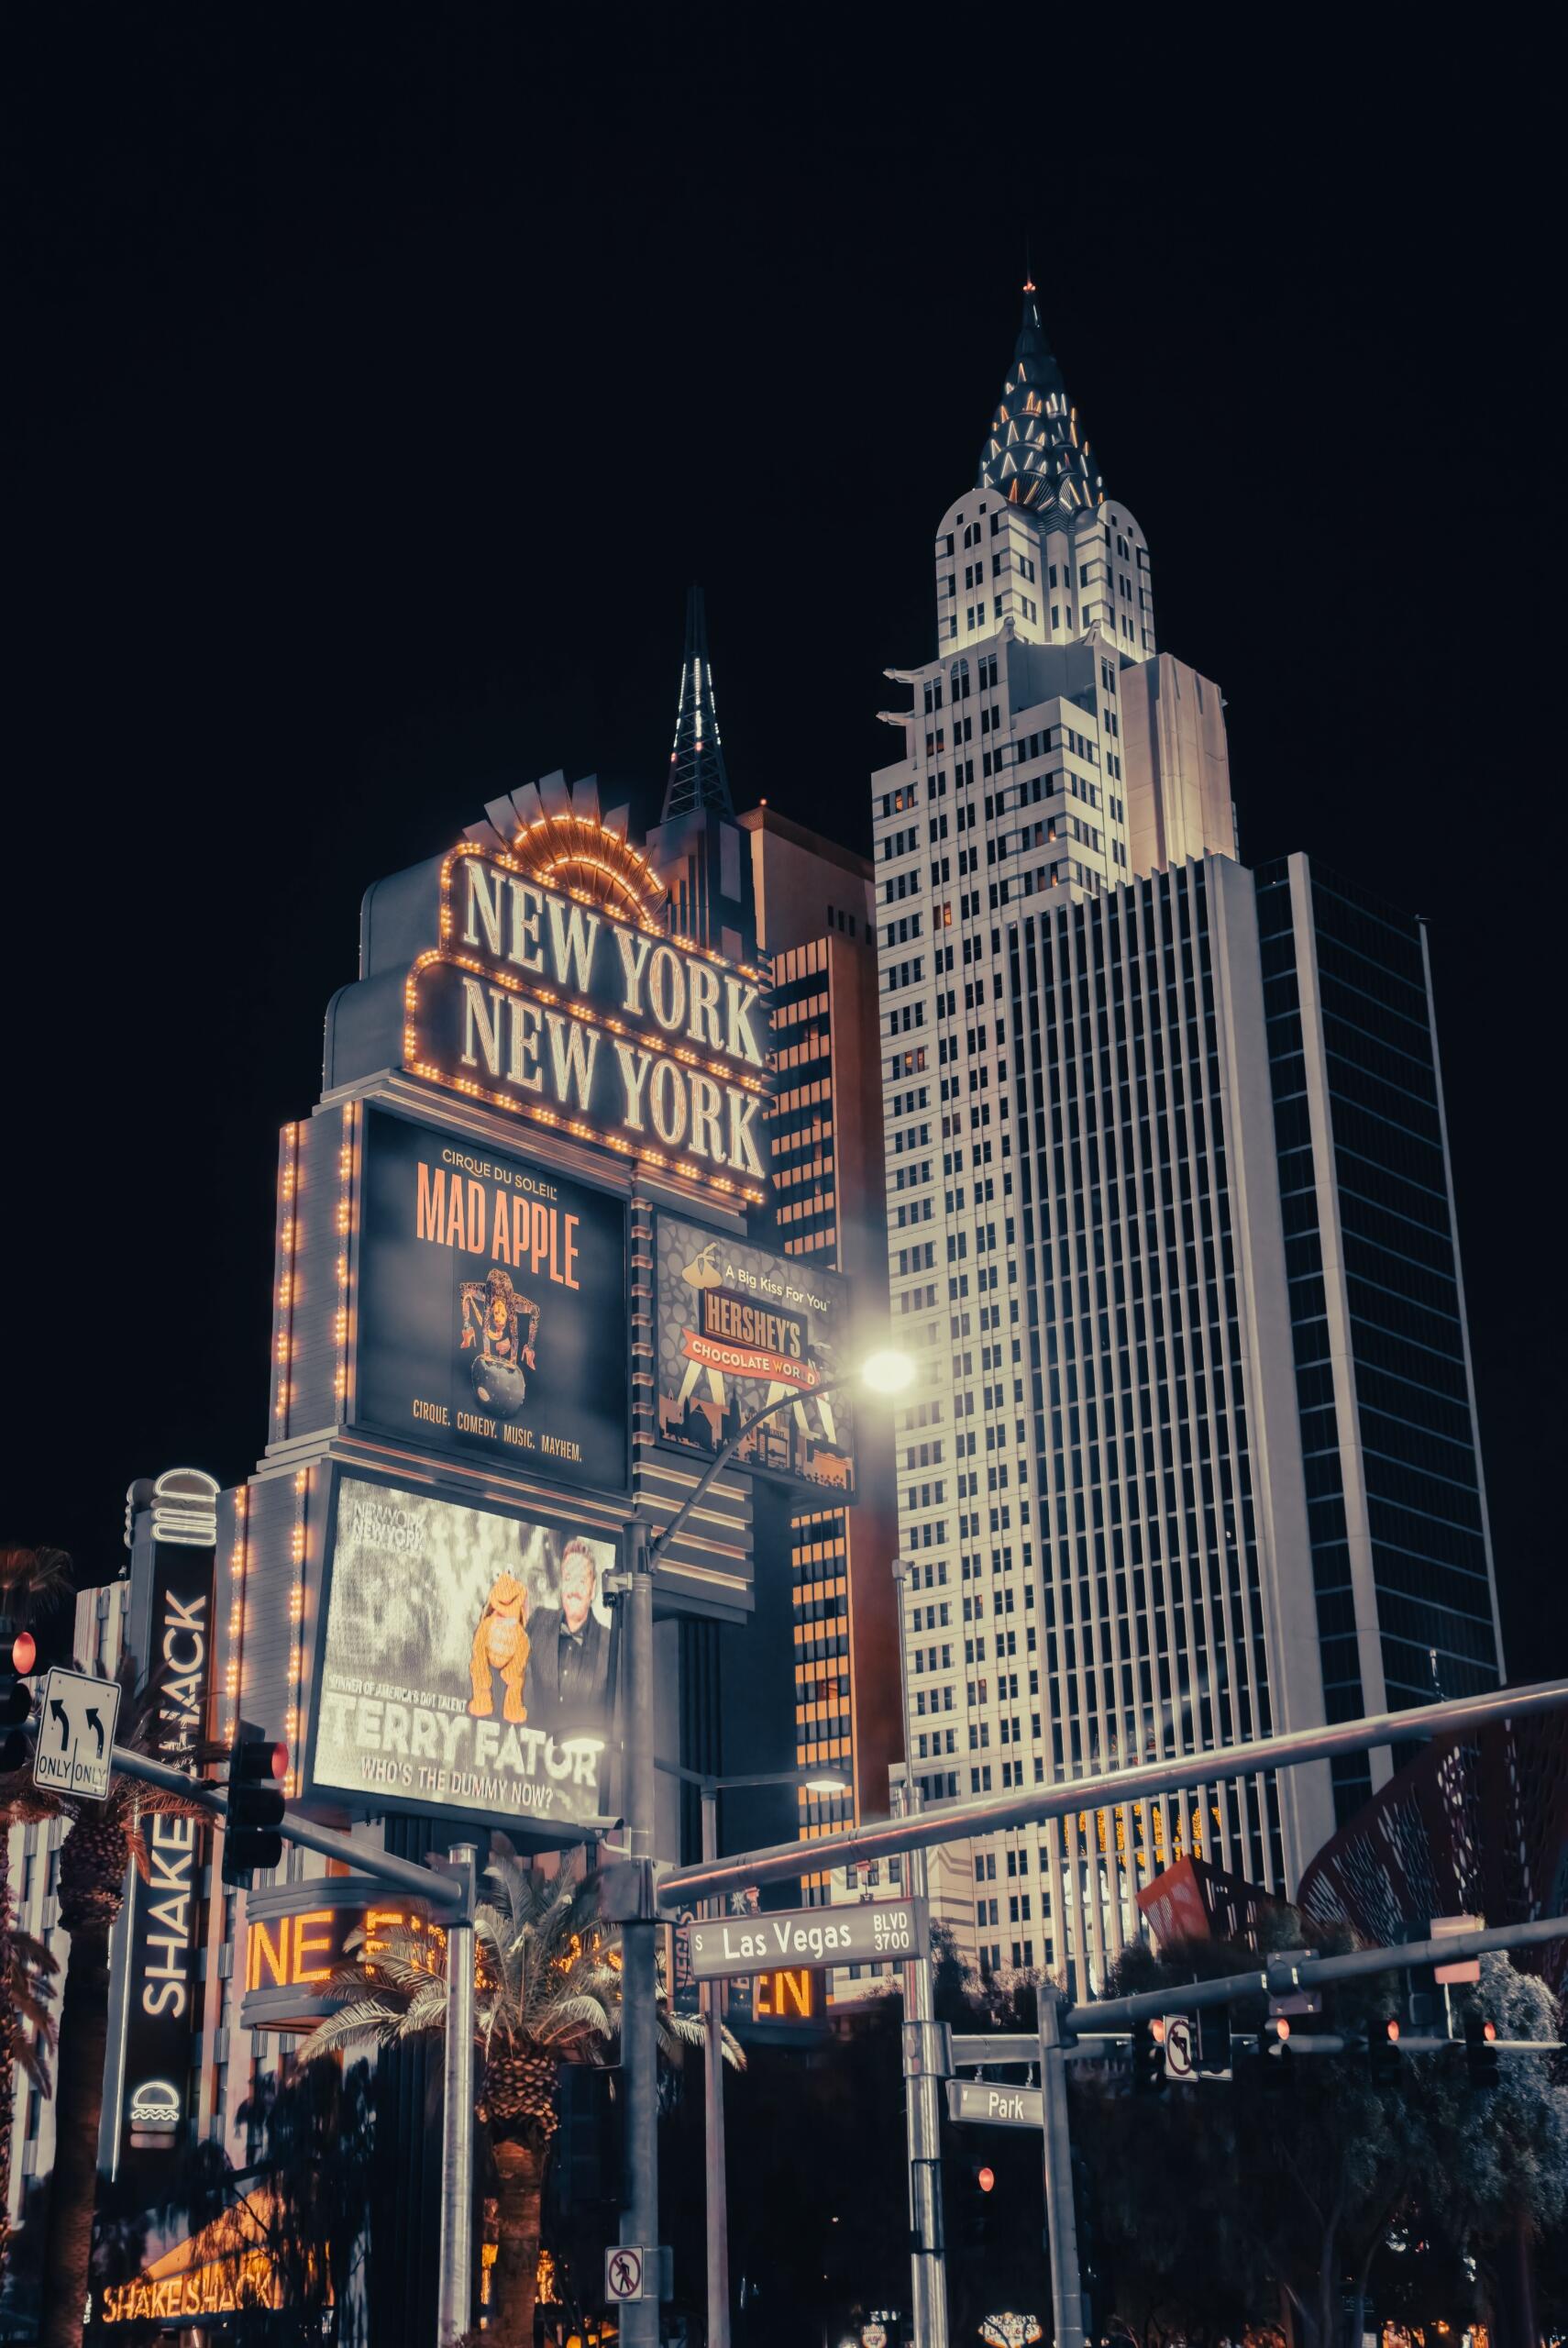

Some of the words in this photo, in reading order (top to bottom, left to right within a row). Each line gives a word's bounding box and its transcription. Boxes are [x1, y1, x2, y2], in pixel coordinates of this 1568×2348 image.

[462, 857, 601, 993] NEW
[613, 925, 765, 1069] YORK
[461, 975, 601, 1112] NEW
[613, 1037, 767, 1180] YORK
[442, 1148, 491, 1178] CIRQUE
[493, 1166, 512, 1185] DU
[514, 1175, 558, 1201] SOLEIL
[416, 1161, 487, 1255] MAD
[491, 1191, 580, 1291] APPLE
[725, 1265, 734, 1279] A
[738, 1268, 756, 1289] Big
[760, 1277, 783, 1296] Kiss
[786, 1286, 804, 1302] For
[706, 1293, 801, 1359] HERSHEY'S
[691, 1339, 771, 1372] CHOCOLATE
[413, 1399, 451, 1427] CIRQUE.
[457, 1412, 498, 1439] COMEDY.
[503, 1423, 536, 1450] MUSIC.
[541, 1434, 583, 1463] MAYHEM.
[322, 1691, 471, 1763] TERRY
[39, 1755, 72, 1778] ONLY
[75, 1764, 106, 1787] ONLY
[360, 1756, 413, 1788] WHO'S
[418, 1767, 446, 1791] THE
[452, 1771, 508, 1801] DUMMY
[511, 1781, 554, 1809] NOW?
[142, 1811, 194, 2018] SHAKE
[873, 1911, 908, 1932] BLVD
[695, 1933, 703, 1952] S
[723, 1927, 767, 1960] Las
[773, 1921, 852, 1960] Vegas
[875, 1931, 910, 1952] 3700
[988, 2091, 1024, 2121] Park
[102, 2281, 182, 2323] SHAKE
